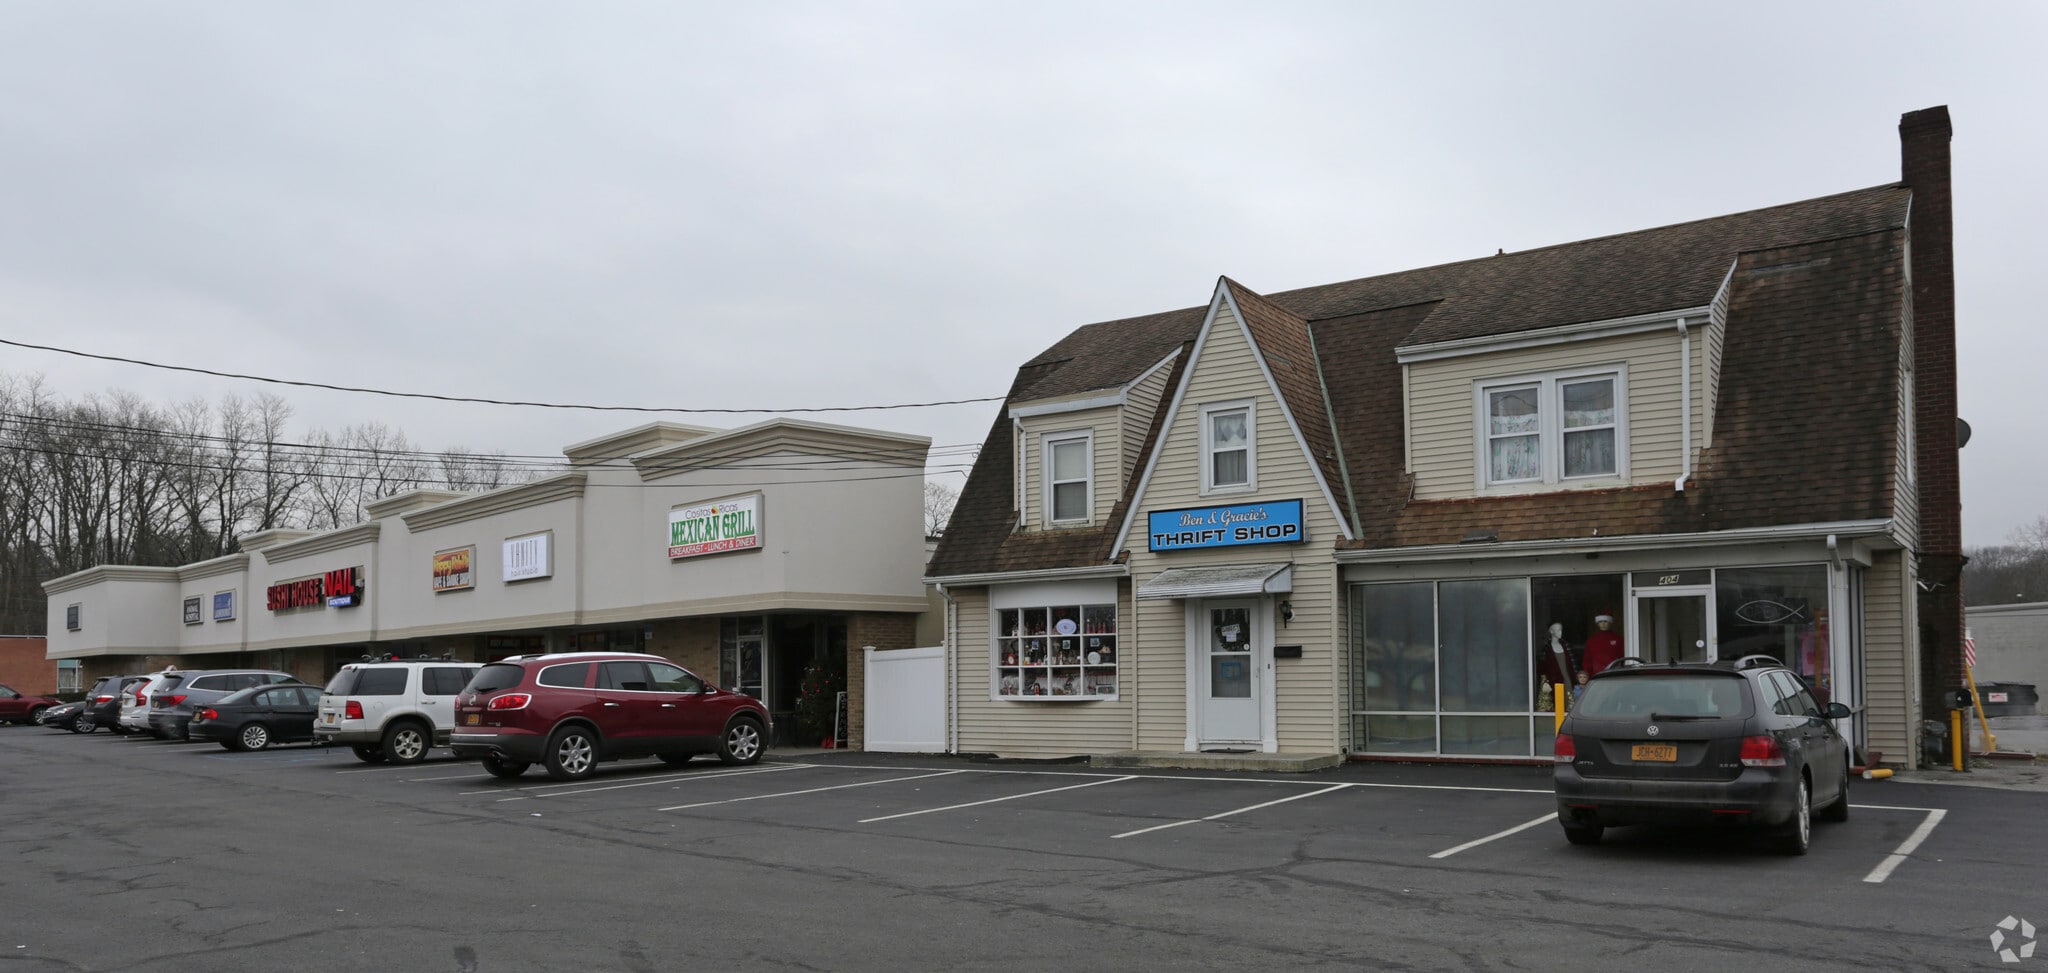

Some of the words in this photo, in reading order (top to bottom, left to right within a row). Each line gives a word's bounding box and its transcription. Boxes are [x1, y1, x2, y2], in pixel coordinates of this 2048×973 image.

[685, 508, 711, 519] Cositas
[718, 503, 738, 514] Ricas
[1178, 513, 1203, 527] Ben
[1207, 511, 1217, 524] &
[1220, 507, 1267, 527] Gracie's
[670, 515, 720, 546] MEXICAN
[722, 509, 755, 540] GRILL
[1153, 529, 1226, 547] THRIFT
[1234, 523, 1297, 541] SHOP
[510, 540, 538, 568] VANITY
[670, 545, 704, 556] BREAKFAST
[707, 540, 727, 552] LUNCH
[728, 540, 734, 549] &
[735, 536, 755, 547] DINER
[324, 567, 355, 598] NAIL
[1659, 574, 1679, 585] 404
[267, 583, 291, 611] SUSHI
[291, 578, 321, 608] HOUSE
